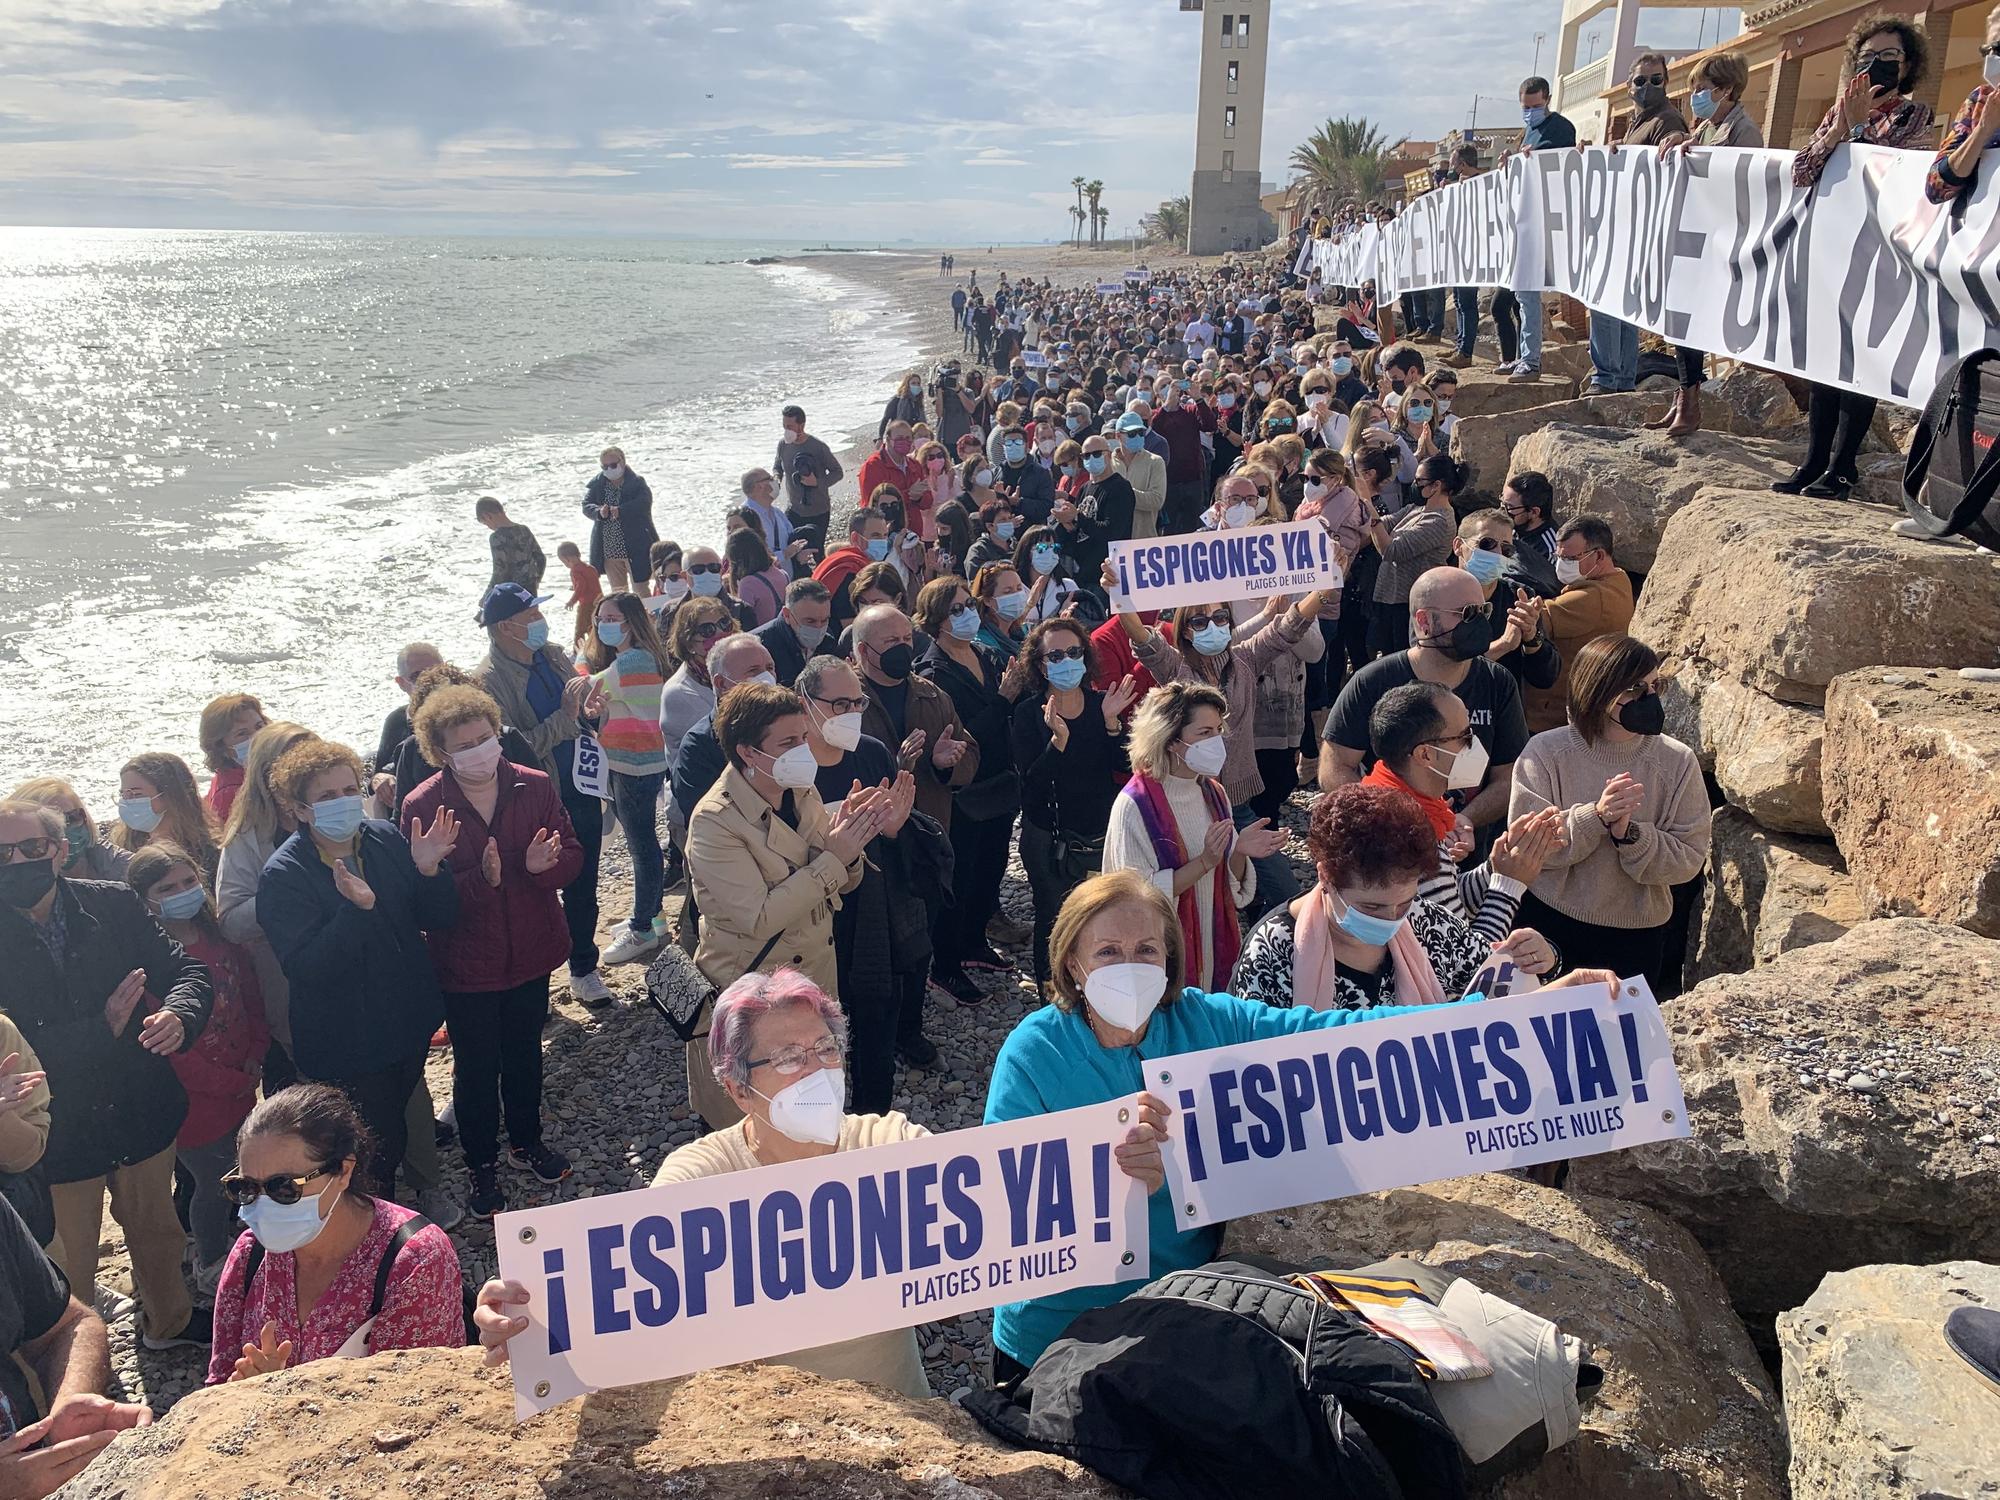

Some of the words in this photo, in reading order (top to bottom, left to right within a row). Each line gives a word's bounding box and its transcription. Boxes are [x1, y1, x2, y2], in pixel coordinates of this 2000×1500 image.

[1444, 171, 1504, 284] NULES
[1538, 149, 1628, 304] FORT
[1623, 149, 1713, 341] QUE
[1722, 153, 1818, 371] UN
[1134, 534, 1277, 589] ESPIGONES
[1245, 575, 1277, 591] PLATGES
[1280, 574, 1290, 587] DE
[1292, 572, 1316, 586] NULES
[577, 736, 600, 779] ESP
[1209, 1021, 1532, 1165] ESPIGONES
[1465, 1121, 1539, 1156] PLATGES
[1542, 1116, 1568, 1143] DE
[1569, 1106, 1625, 1138] NULES
[588, 1155, 983, 1335] ESPIGONES
[901, 1271, 981, 1309] PLATGES
[988, 1261, 1012, 1289] DE
[1018, 1245, 1077, 1282] NULES
